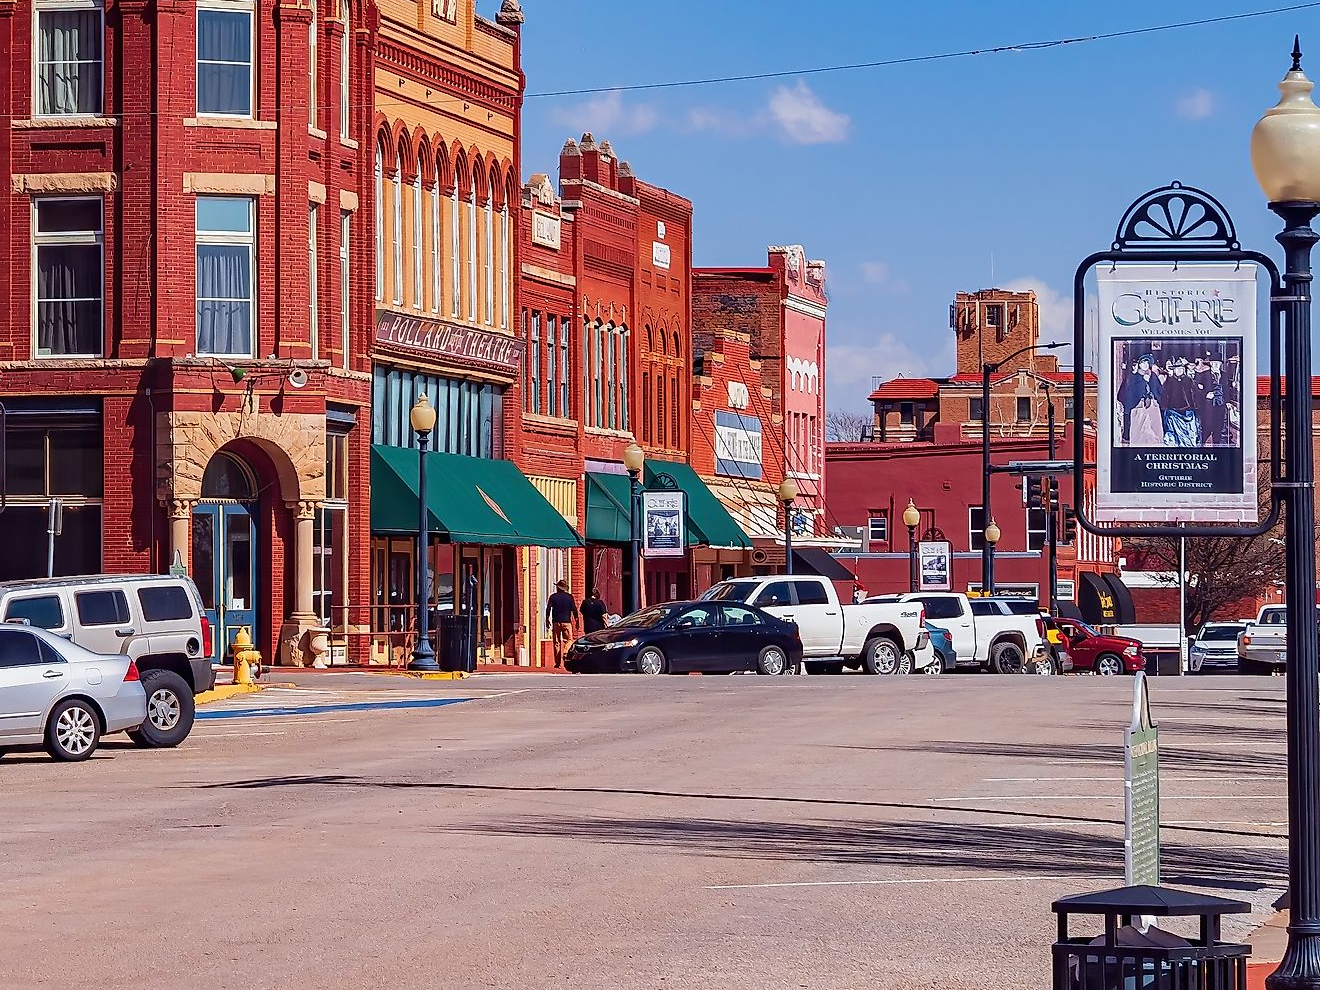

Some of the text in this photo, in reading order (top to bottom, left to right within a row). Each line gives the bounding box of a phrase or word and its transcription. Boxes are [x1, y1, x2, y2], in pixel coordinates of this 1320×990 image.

[1111, 293, 1240, 328] GUTHRIE
[388, 317, 515, 363] POLLARD THEATRE
[1134, 453, 1217, 461] A TERRITORIAL
[1145, 462, 1209, 470] CHRISTMAS
